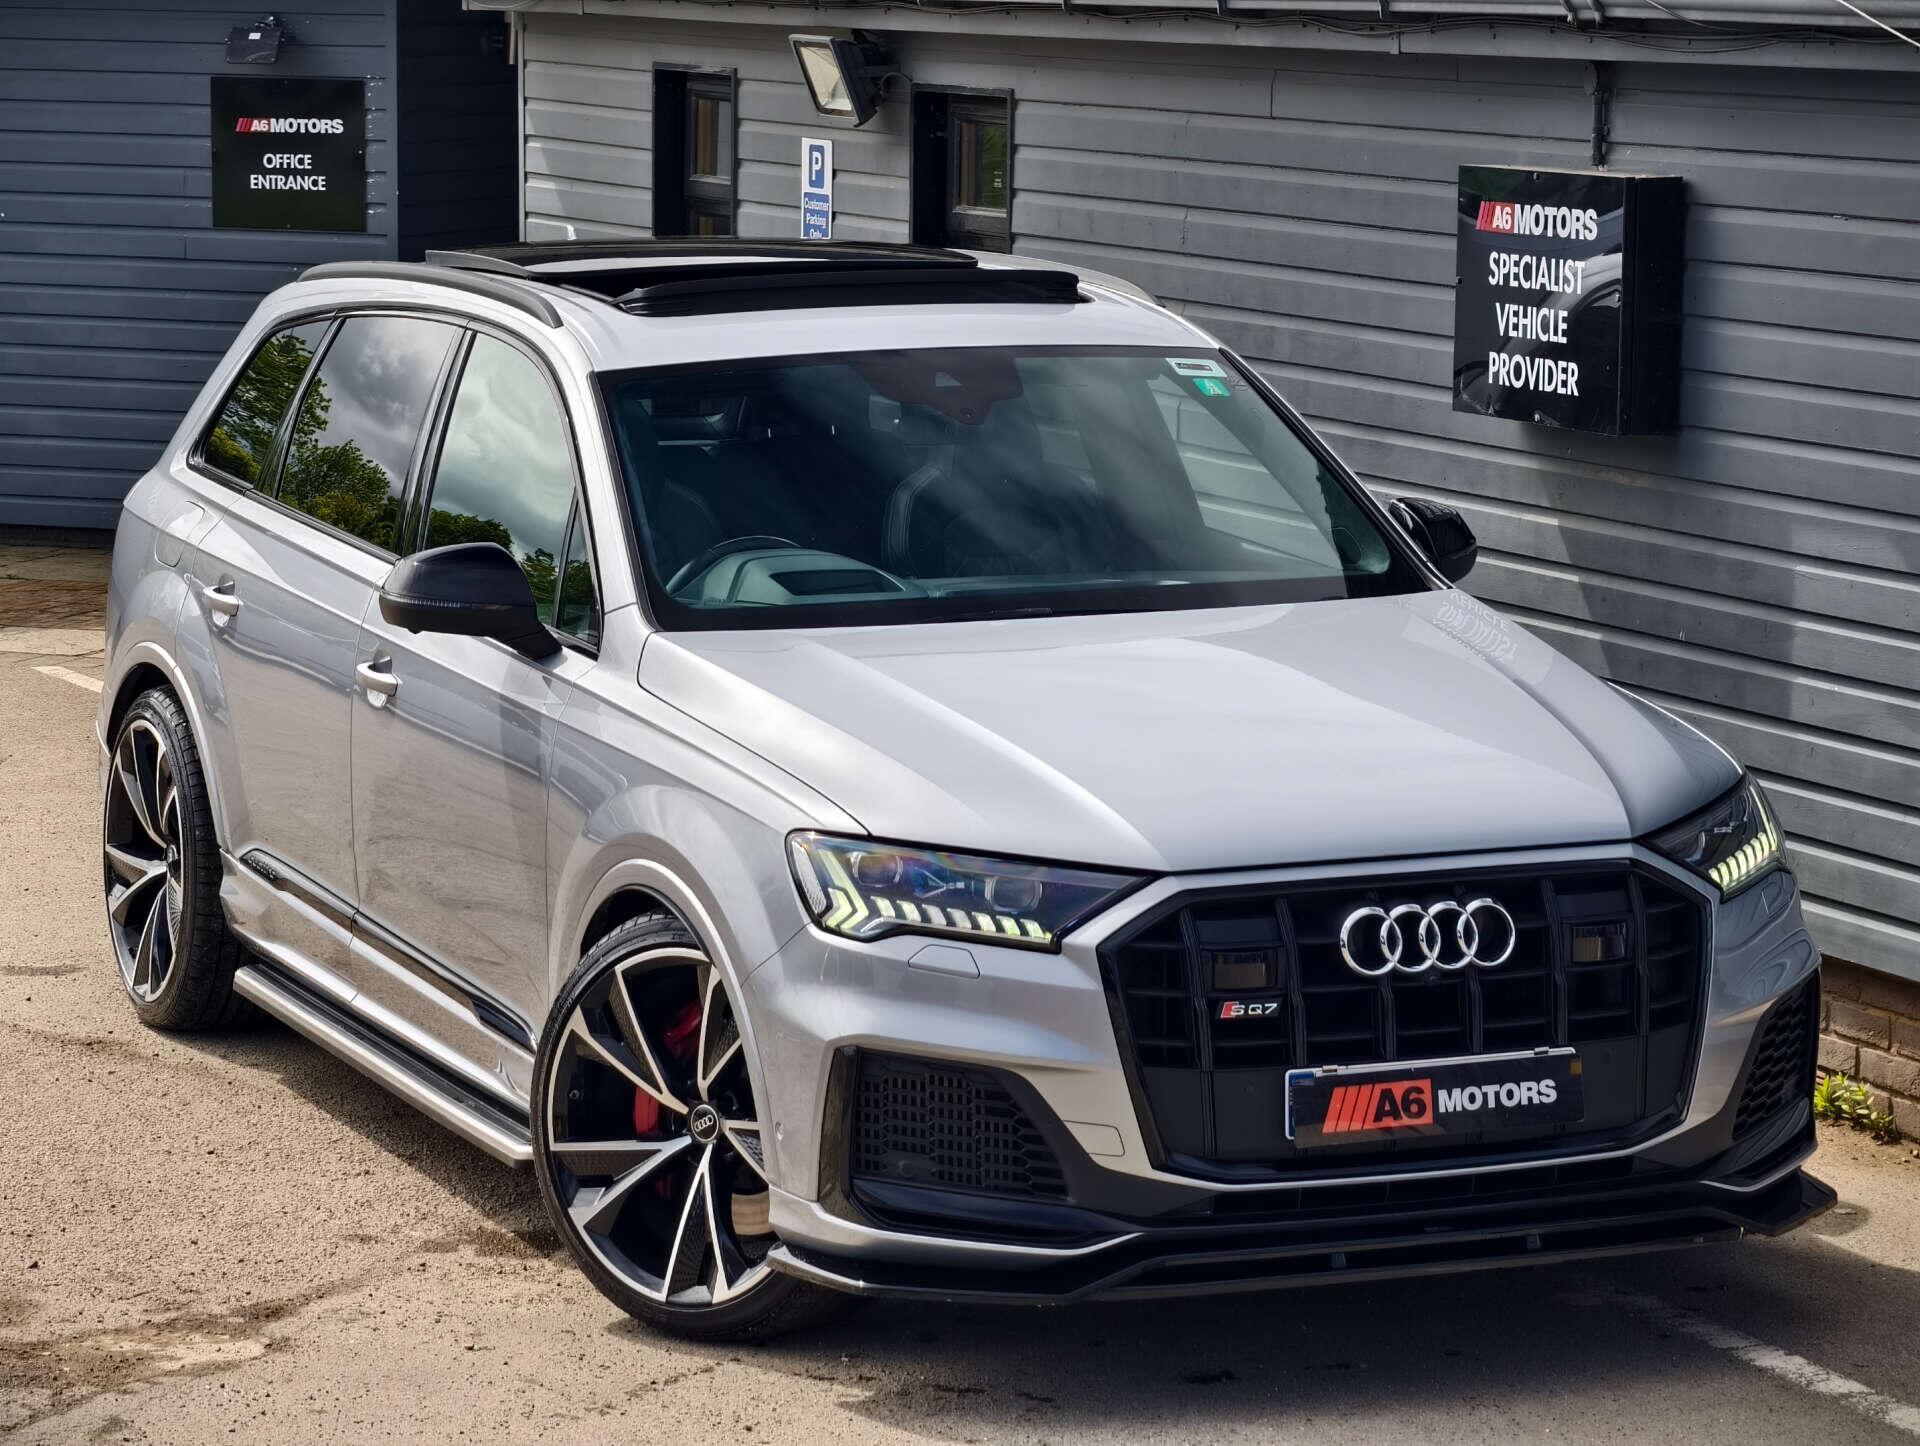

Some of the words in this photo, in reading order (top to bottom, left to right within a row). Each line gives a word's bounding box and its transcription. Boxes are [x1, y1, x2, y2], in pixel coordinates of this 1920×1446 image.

[270, 118, 344, 133] MOTORS
[263, 153, 312, 169] OFFICE
[812, 151, 822, 181] P
[250, 174, 326, 191] ENTRANCE
[804, 198, 829, 211] Customer
[806, 212, 827, 229] Parking
[1513, 203, 1598, 241] MOTORS
[1488, 251, 1586, 295] SPECIALIST
[1495, 302, 1568, 344] VEHICLE
[1488, 351, 1579, 397] PROVIDER
[1230, 1003, 1278, 1016] SQ7
[1372, 1085, 1428, 1123] A6
[1438, 1078, 1558, 1114] MOTORS
